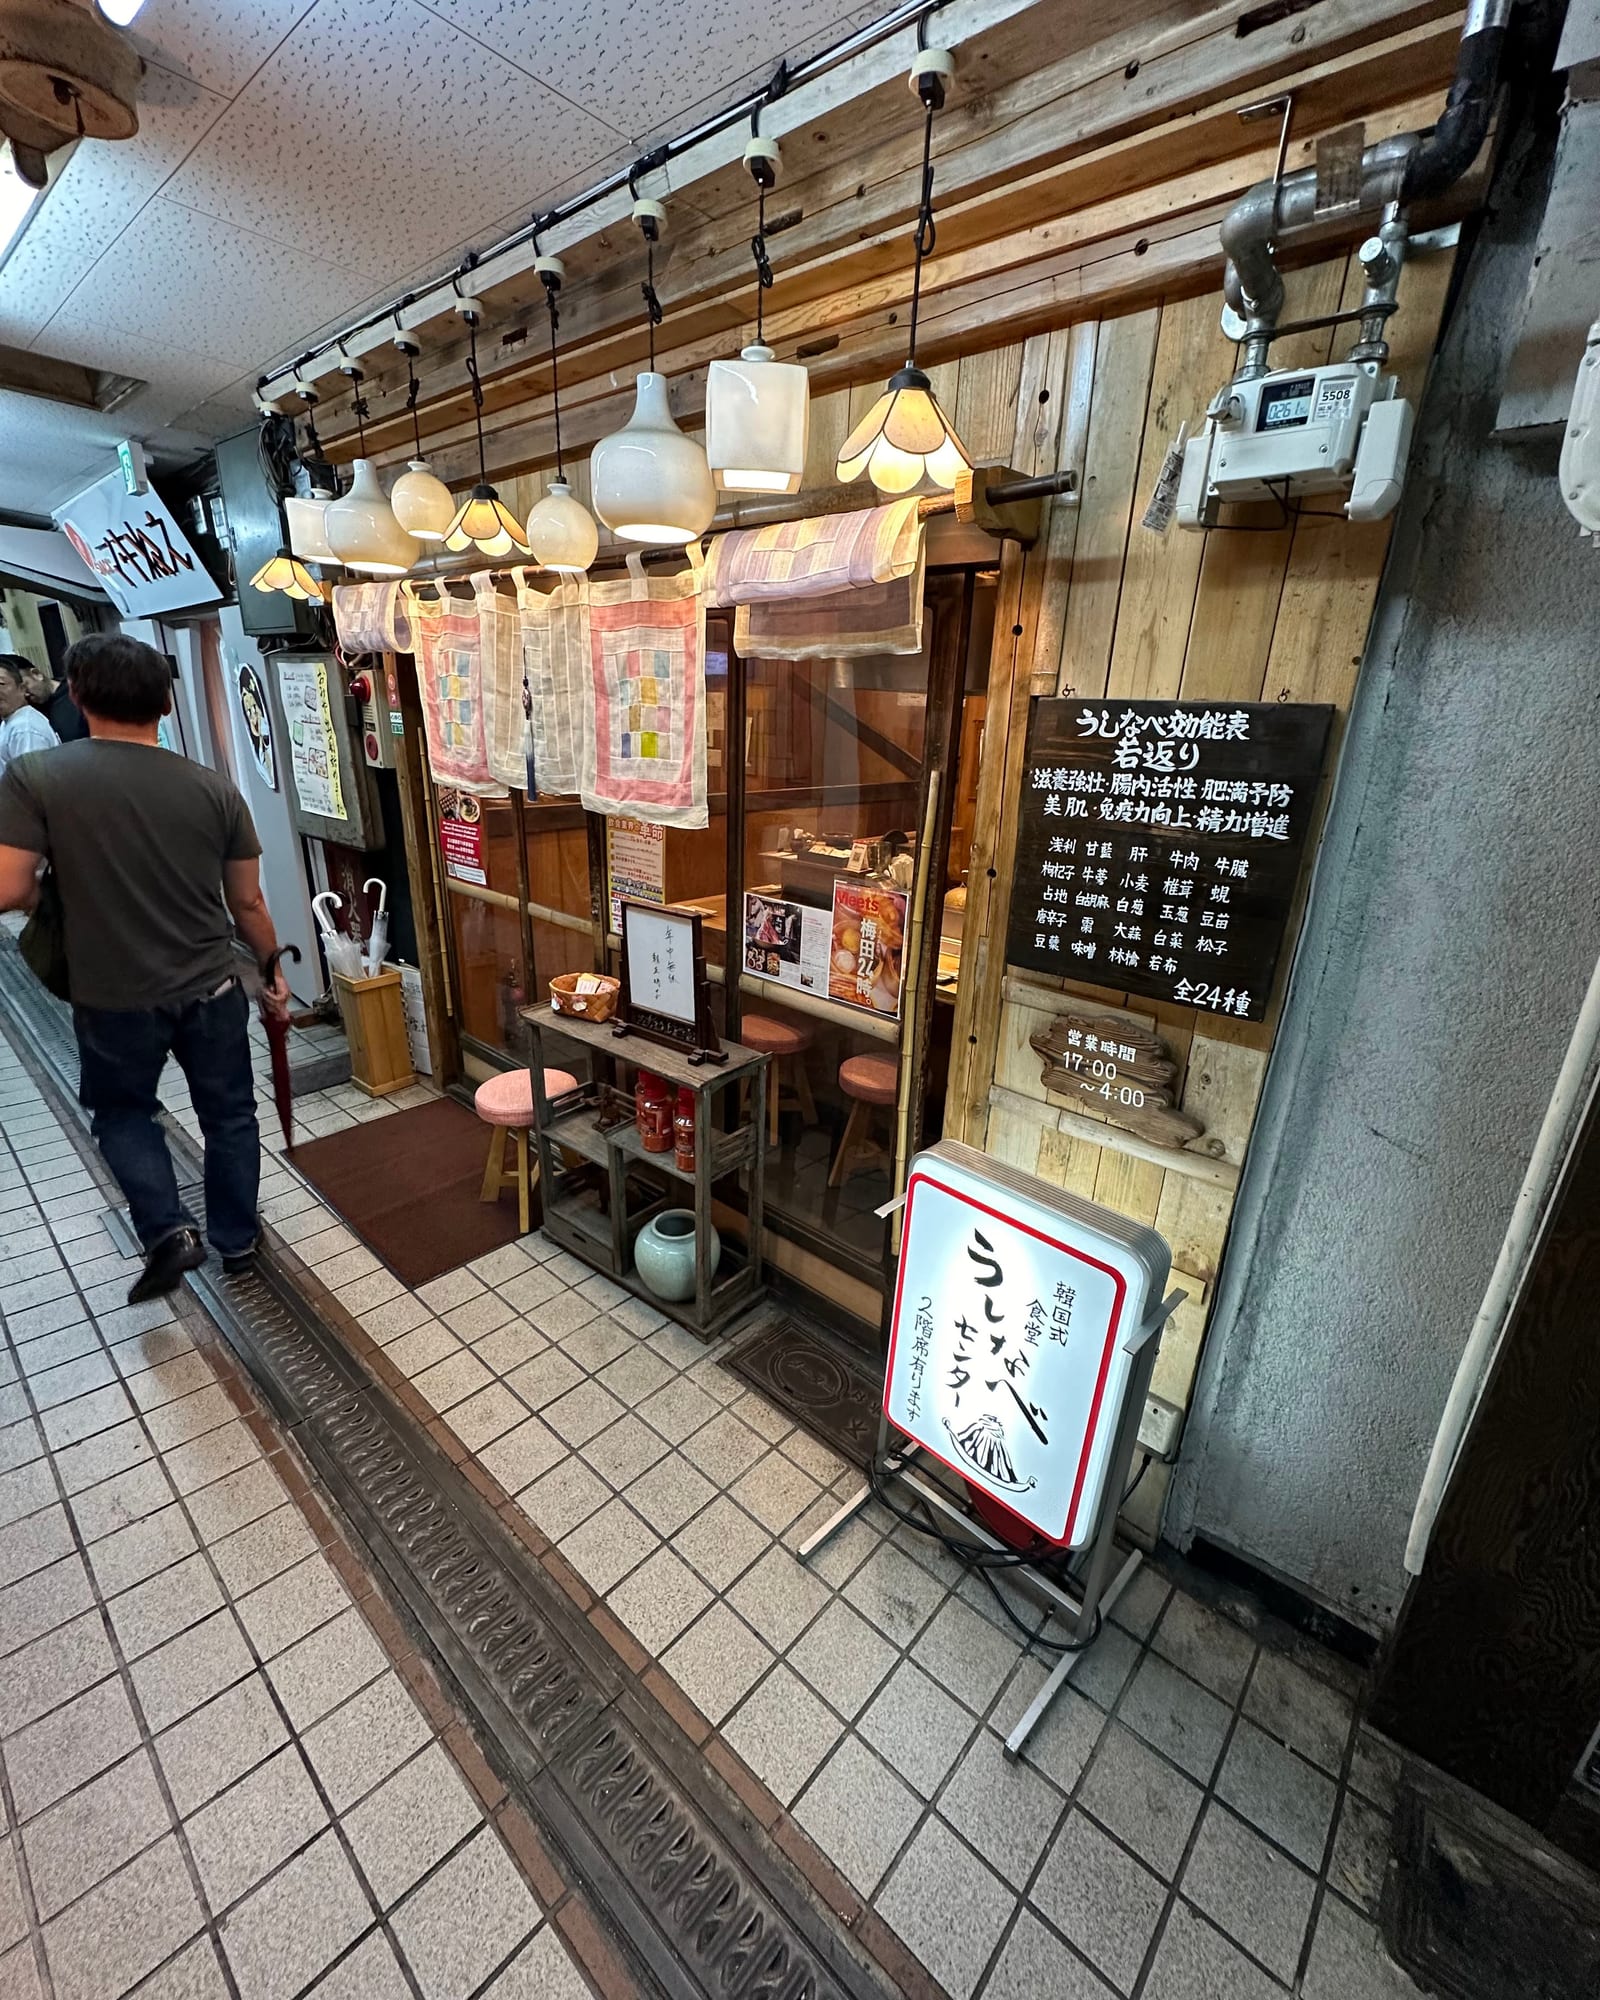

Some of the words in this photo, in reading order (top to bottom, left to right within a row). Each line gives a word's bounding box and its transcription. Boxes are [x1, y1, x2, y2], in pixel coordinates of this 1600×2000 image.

[1321, 389, 1351, 402] 5508
[1075, 707, 1250, 741] うしなべ効能表
[1110, 736, 1201, 773] 若返り
[1128, 846, 1148, 862] 肝
[1169, 849, 1200, 871] 牛肉
[1119, 872, 1150, 893] 小麦
[1162, 876, 1195, 899] 椎茸
[1042, 885, 1069, 904] 占地
[1075, 890, 1111, 910] 白胡麻
[1199, 910, 1231, 930] 豆苗
[1035, 908, 1068, 928] 唐辛子
[1194, 935, 1229, 956] 松子
[1070, 939, 1098, 960] 味噌
[1148, 955, 1179, 976] 若布
[1173, 977, 1252, 1017] 全24種
[1067, 1028, 1136, 1063] 営業時間
[1062, 1050, 1117, 1081] 17:00
[1024, 1298, 1049, 1347] 食堂
[1048, 1281, 1077, 1347] 韓国式
[966, 1227, 1049, 1446] うしなべ
[944, 1313, 979, 1409] センター
